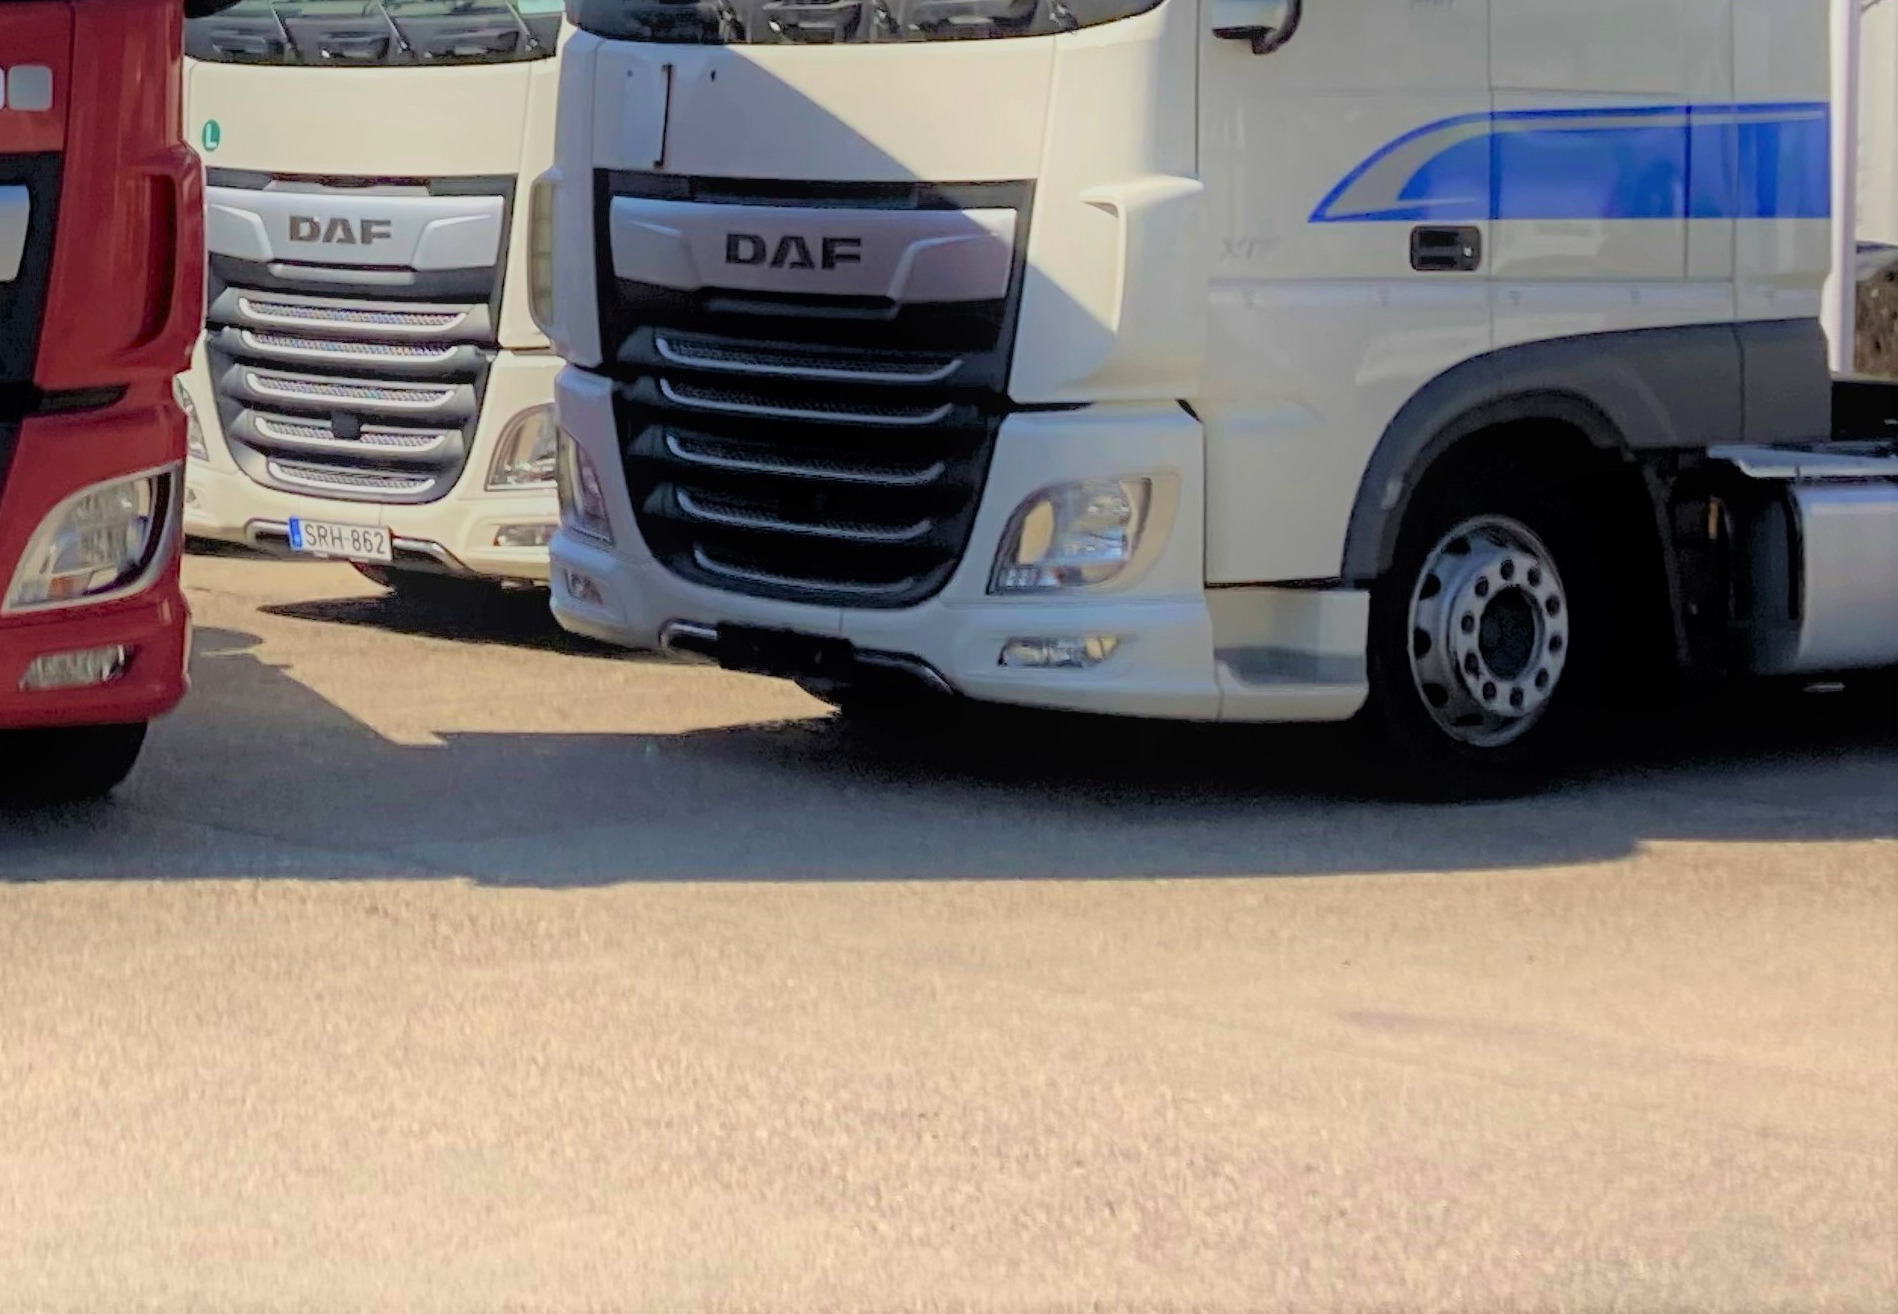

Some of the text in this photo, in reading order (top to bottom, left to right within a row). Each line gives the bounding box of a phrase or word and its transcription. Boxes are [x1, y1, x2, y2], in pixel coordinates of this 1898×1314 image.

[205, 123, 218, 148] L
[288, 215, 392, 244] DAF
[726, 233, 862, 271] DAF
[304, 524, 386, 555] SRH-862
